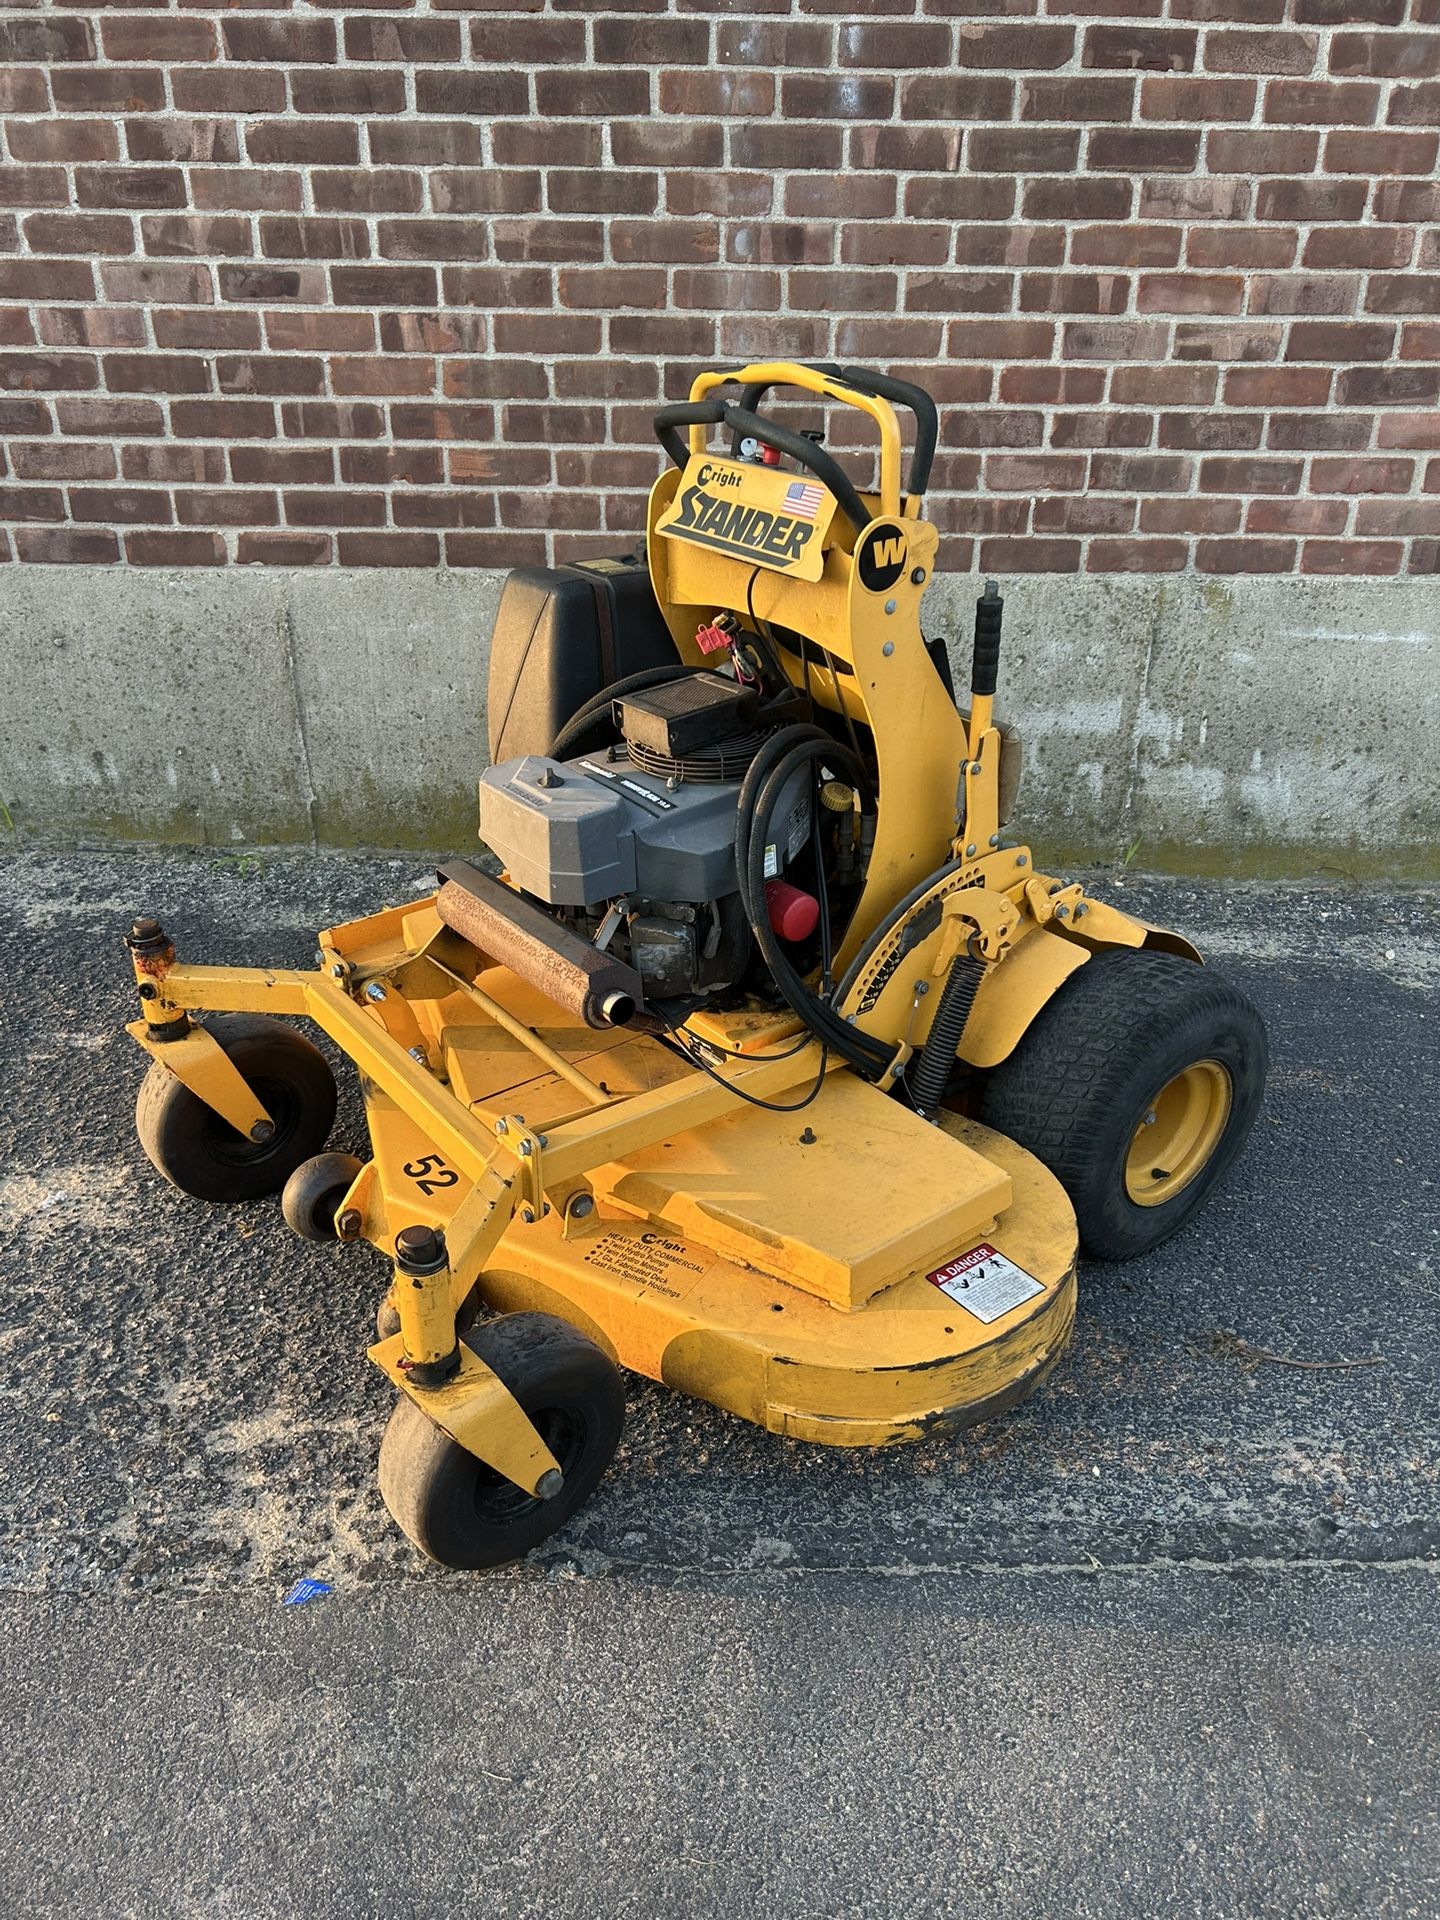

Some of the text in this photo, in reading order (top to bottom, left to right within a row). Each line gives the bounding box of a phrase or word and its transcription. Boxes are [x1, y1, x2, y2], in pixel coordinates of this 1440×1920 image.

[697, 464, 742, 487] Wright
[673, 485, 814, 560] STANDER
[873, 536, 907, 569] W
[403, 1154, 459, 1196] 52
[603, 1246, 663, 1274] Twin Hydro Motors
[607, 1231, 705, 1274] HEAVY DUTY COMMERCIAL
[609, 1240, 669, 1268] Twin Hydro Pumps
[945, 1248, 991, 1276] DANGER
[590, 1258, 681, 1298] Cast Iron Spindle Housings
[614, 1259, 650, 1277] Fabricated
[650, 1273, 668, 1284] Deck
